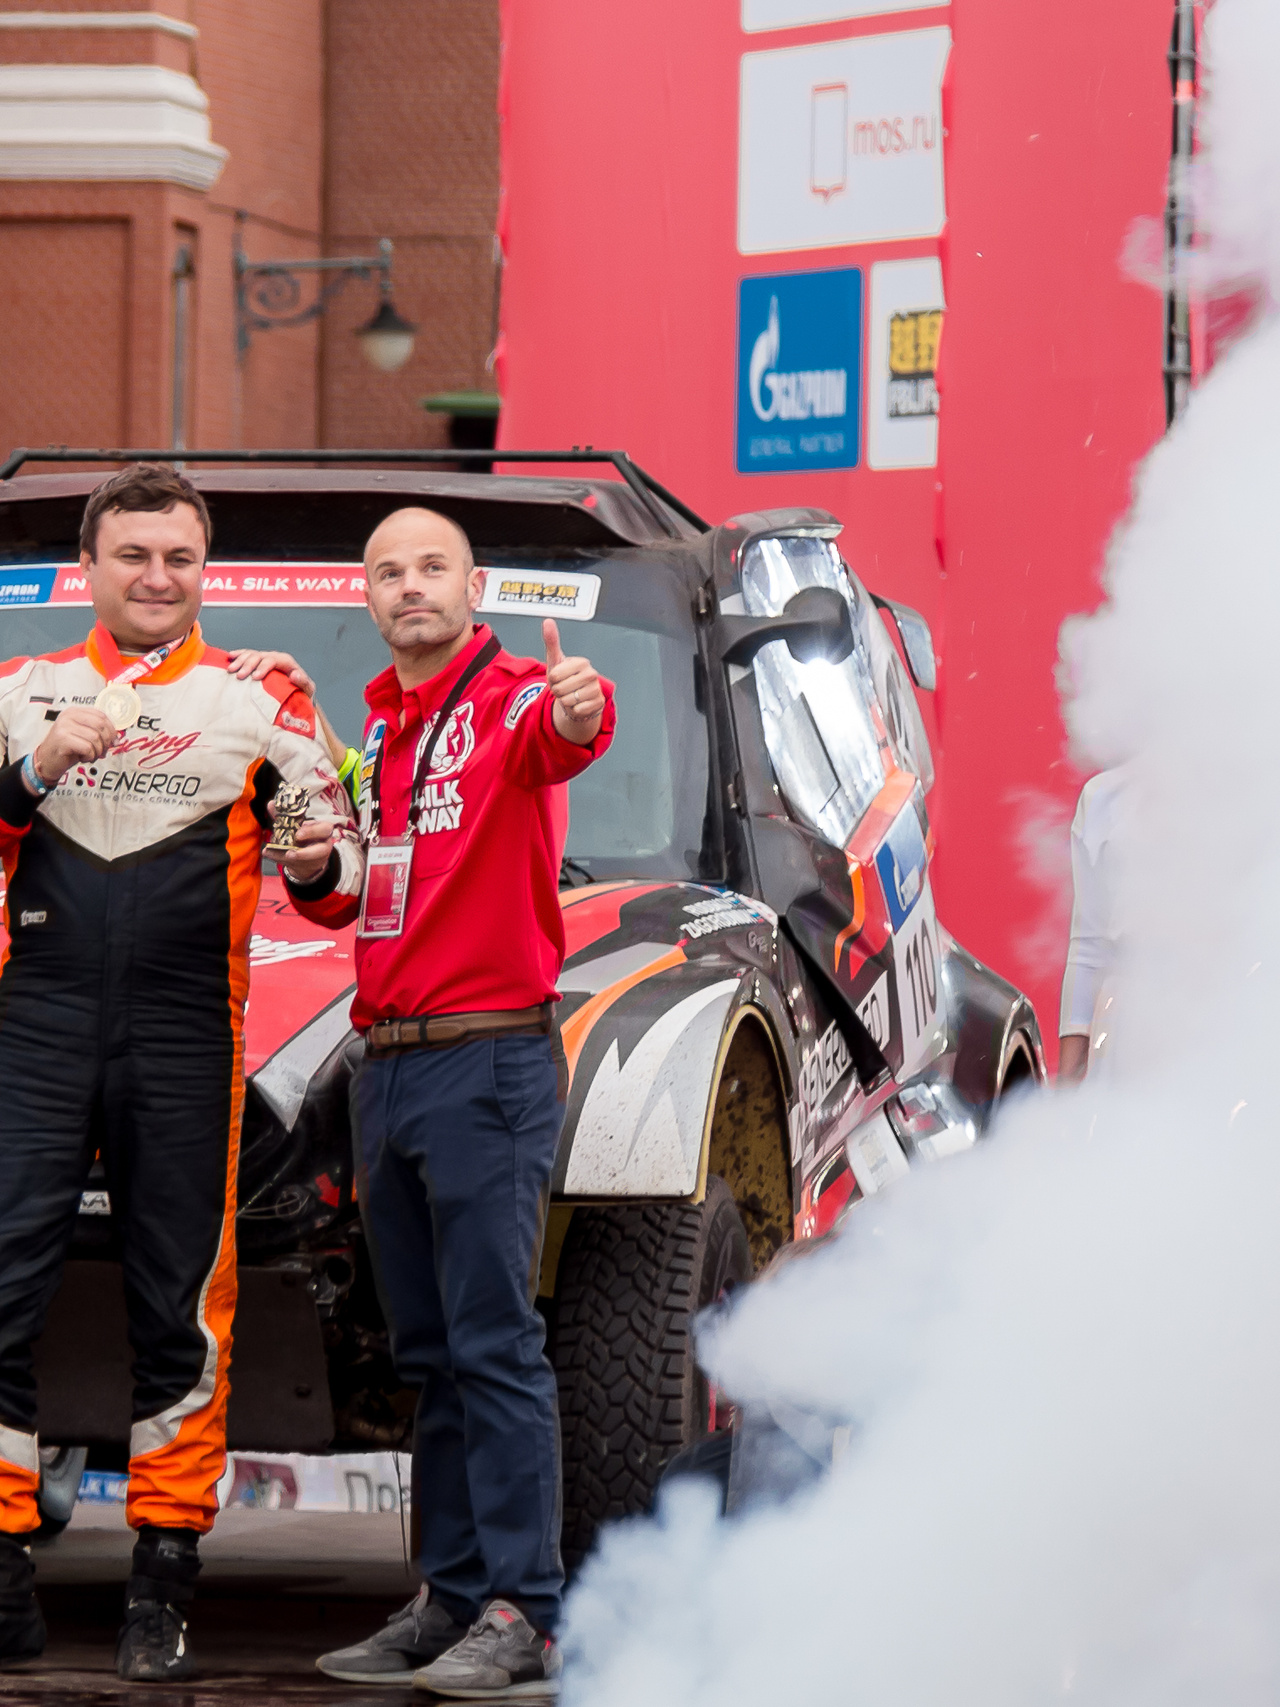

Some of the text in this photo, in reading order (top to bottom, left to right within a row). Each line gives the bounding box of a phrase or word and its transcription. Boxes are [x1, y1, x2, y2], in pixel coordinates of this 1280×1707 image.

[241, 577, 290, 592] SILK
[295, 577, 347, 592] WAY
[100, 770, 202, 797] ENERGO
[906, 917, 937, 1039] 110
